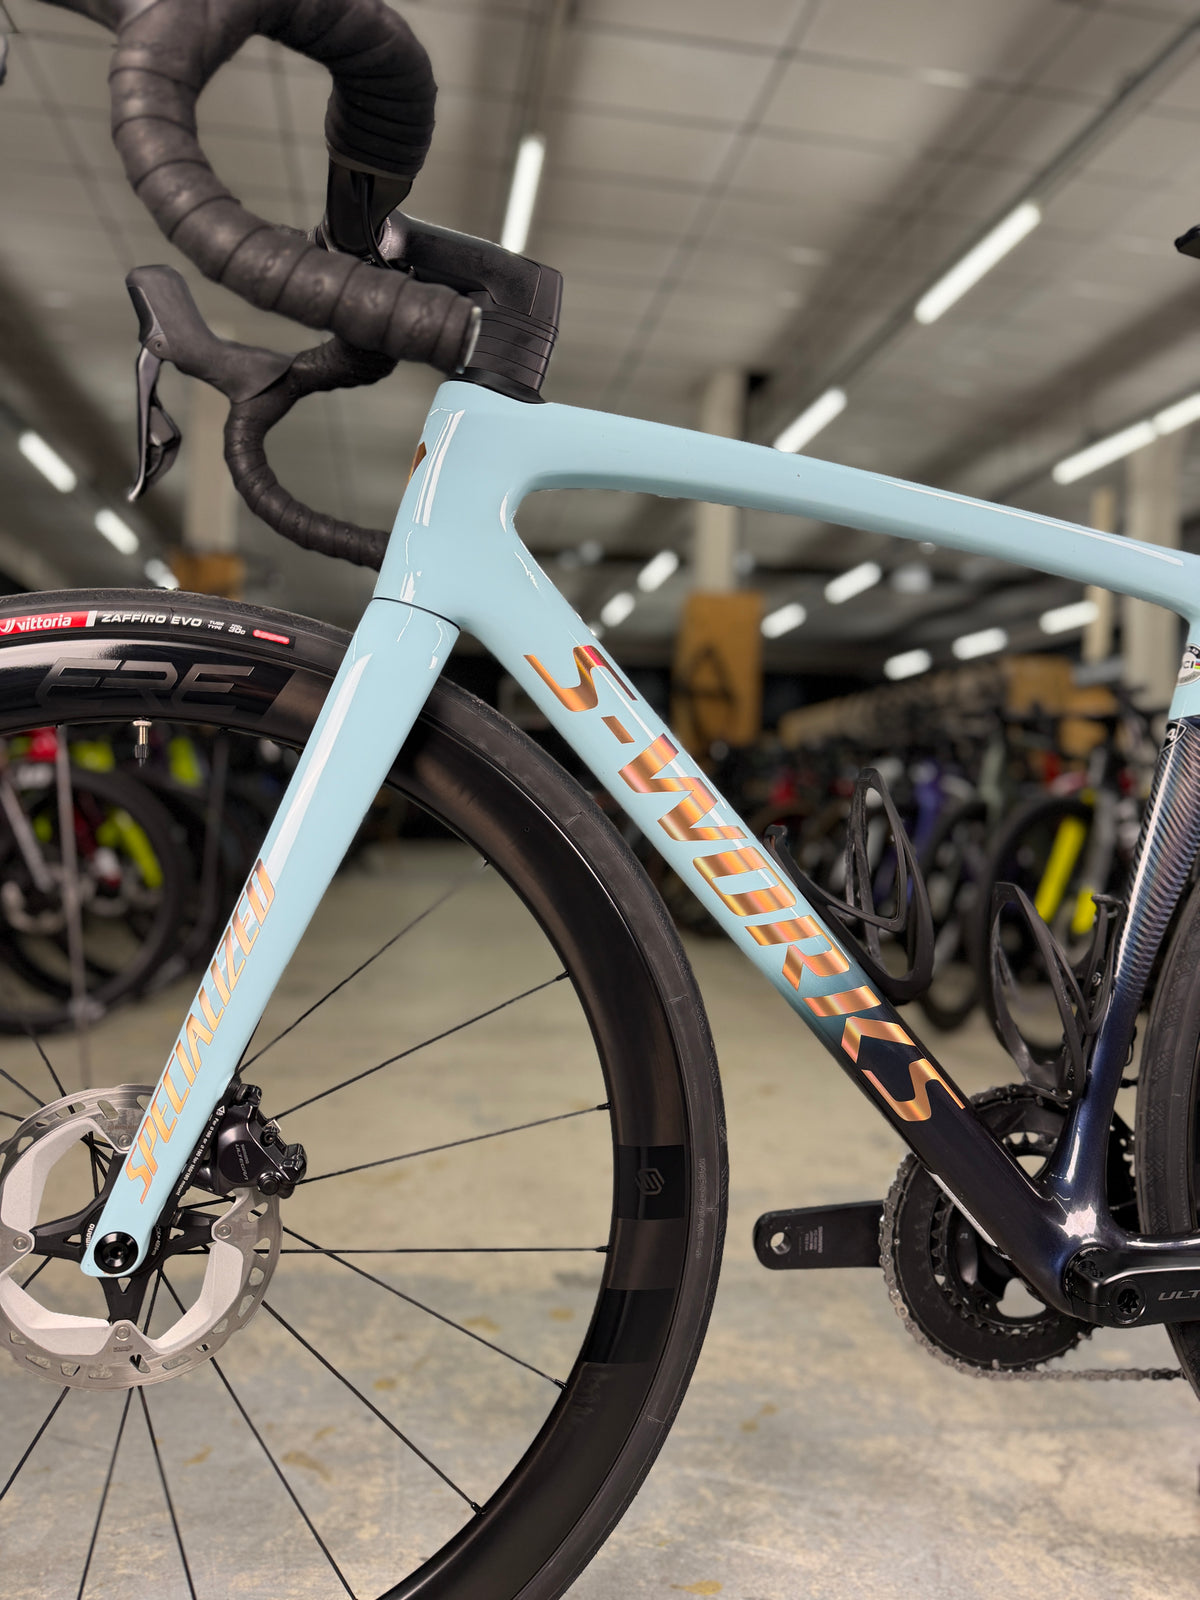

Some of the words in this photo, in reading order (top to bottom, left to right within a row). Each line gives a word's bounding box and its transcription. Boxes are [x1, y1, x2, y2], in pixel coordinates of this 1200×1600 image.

[17, 614, 72, 631] vittoria
[101, 613, 167, 623] ZAFFIRO
[171, 616, 202, 627] EVO
[35, 656, 255, 713] ERE
[524, 645, 967, 1122] S-WORKS
[125, 857, 276, 1205] SPECIALIZED
